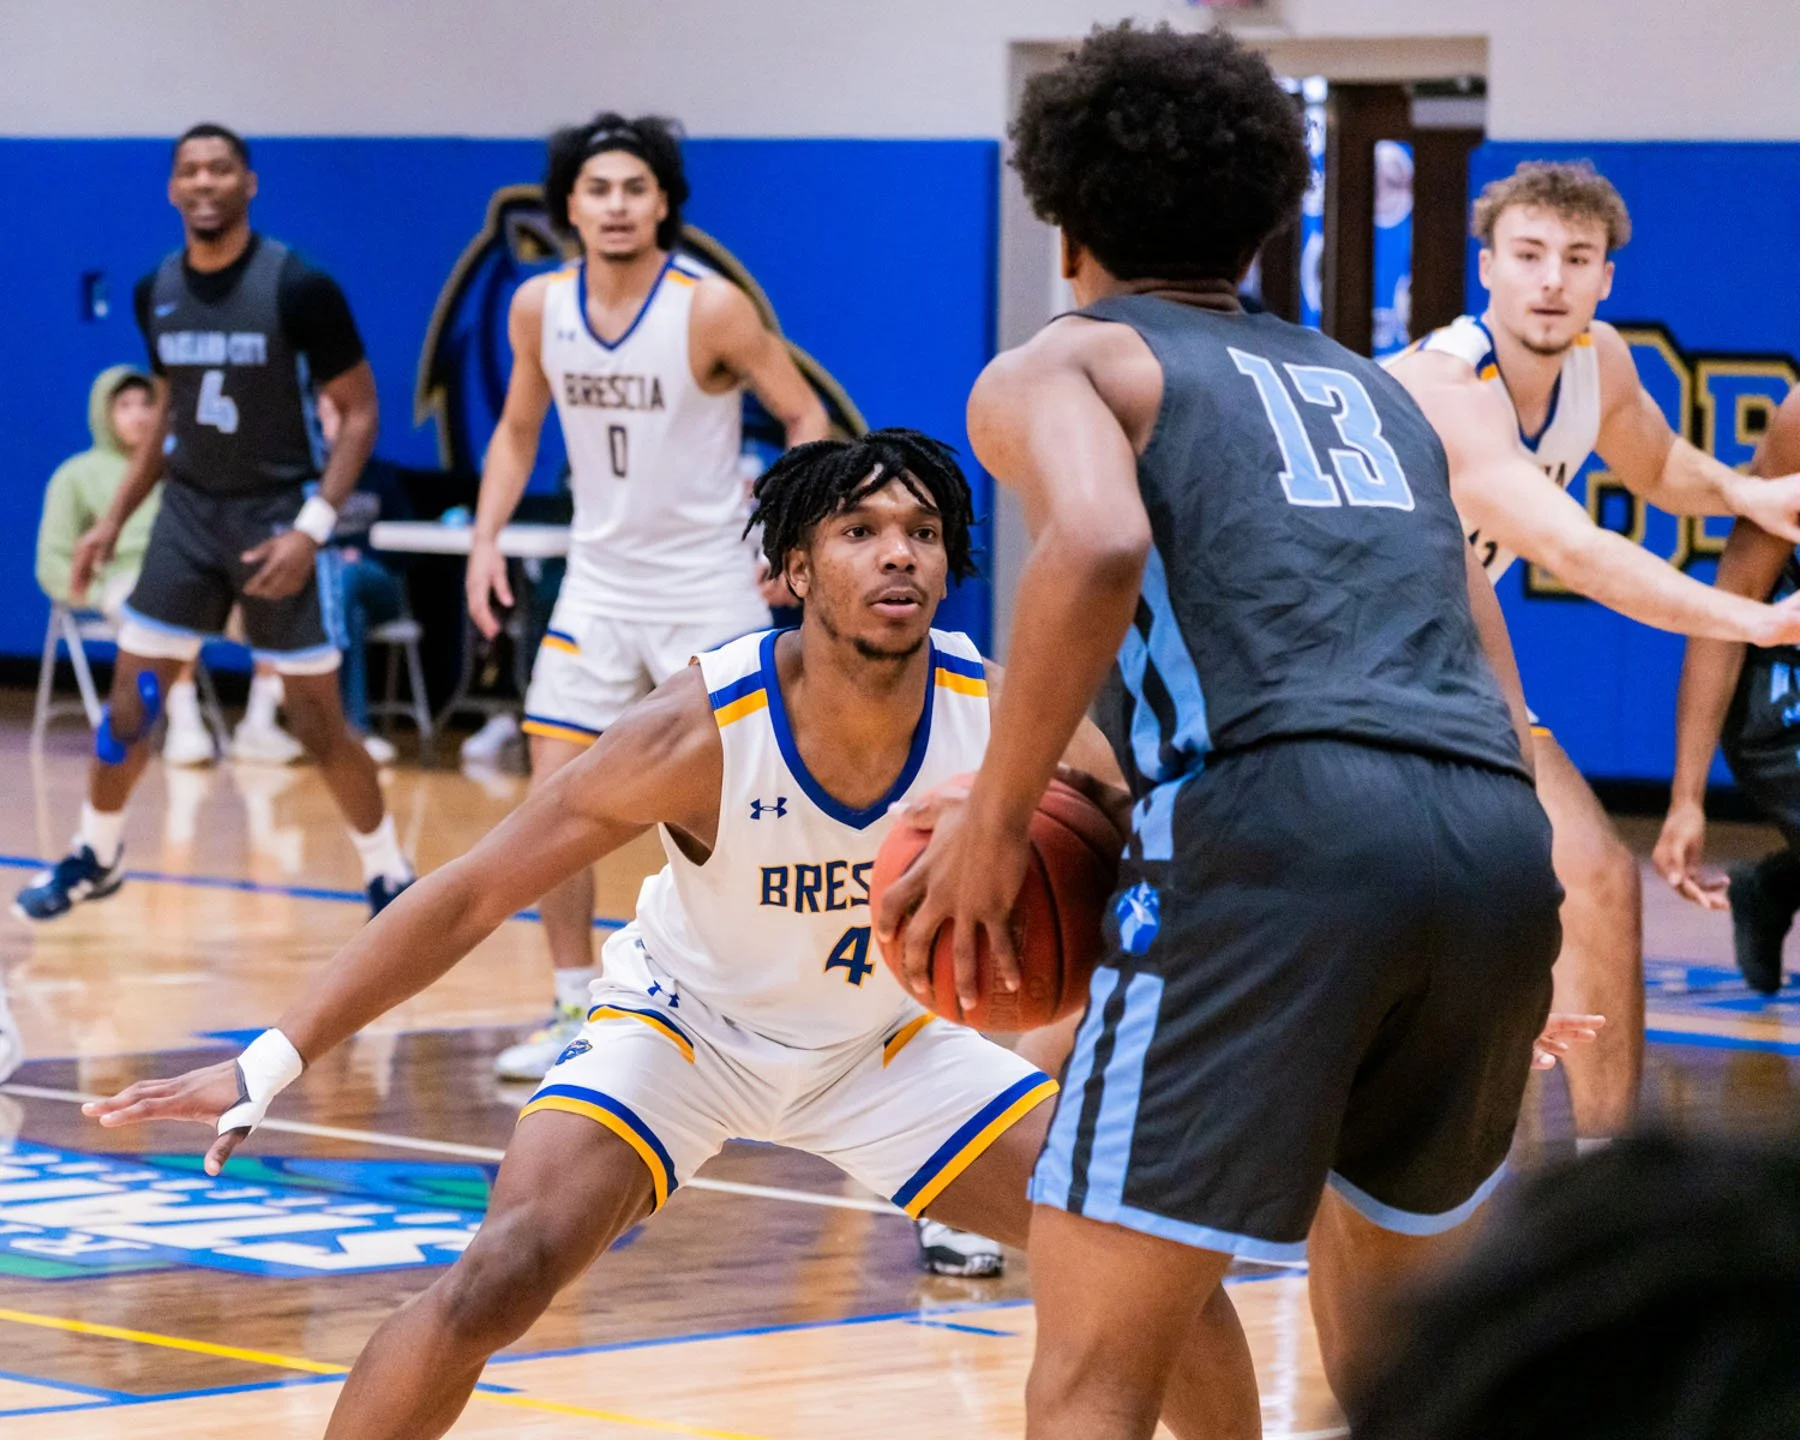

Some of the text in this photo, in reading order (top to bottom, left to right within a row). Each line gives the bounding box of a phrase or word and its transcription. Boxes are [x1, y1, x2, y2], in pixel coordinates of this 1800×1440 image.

[563, 372, 665, 412] BRESCIA
[607, 424, 628, 479] 0
[1226, 346, 1415, 511] 13
[758, 859, 876, 914] BRES
[823, 926, 876, 989] 4
